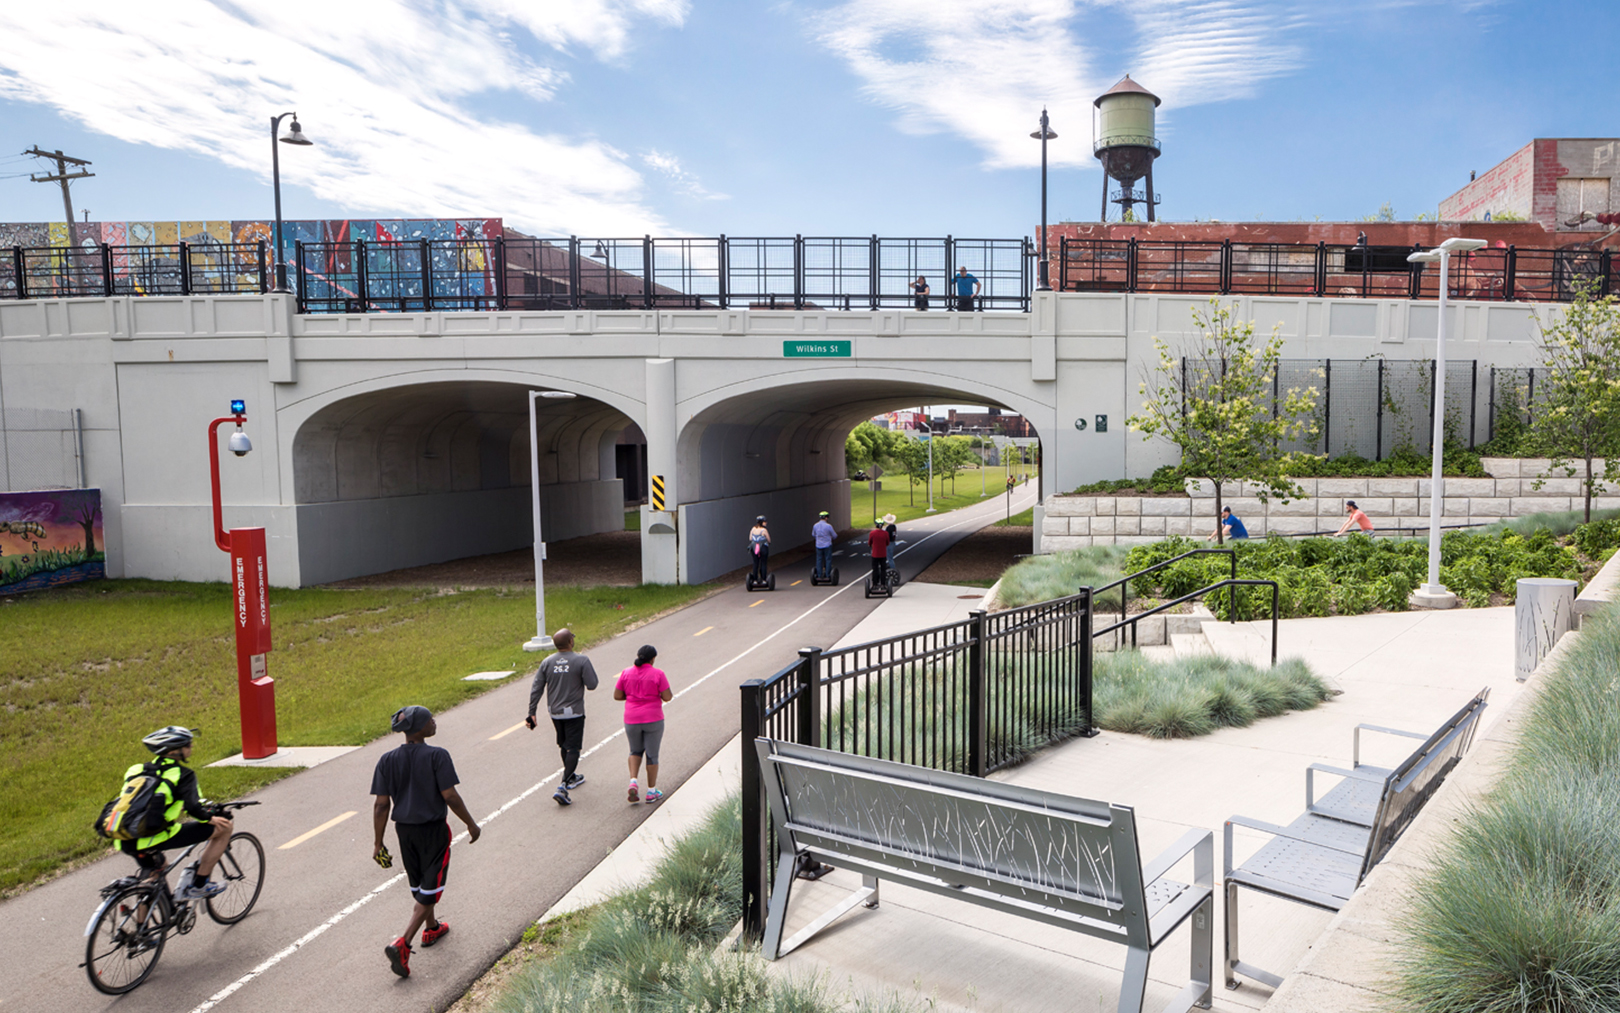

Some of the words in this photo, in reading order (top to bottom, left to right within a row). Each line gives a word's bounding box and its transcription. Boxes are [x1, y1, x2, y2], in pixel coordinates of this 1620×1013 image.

[796, 345, 827, 353] Wilkins
[830, 345, 838, 353] St
[236, 557, 247, 628] EMERGENCY
[257, 556, 266, 625] EMERGENCY
[553, 665, 570, 673] 26.2
